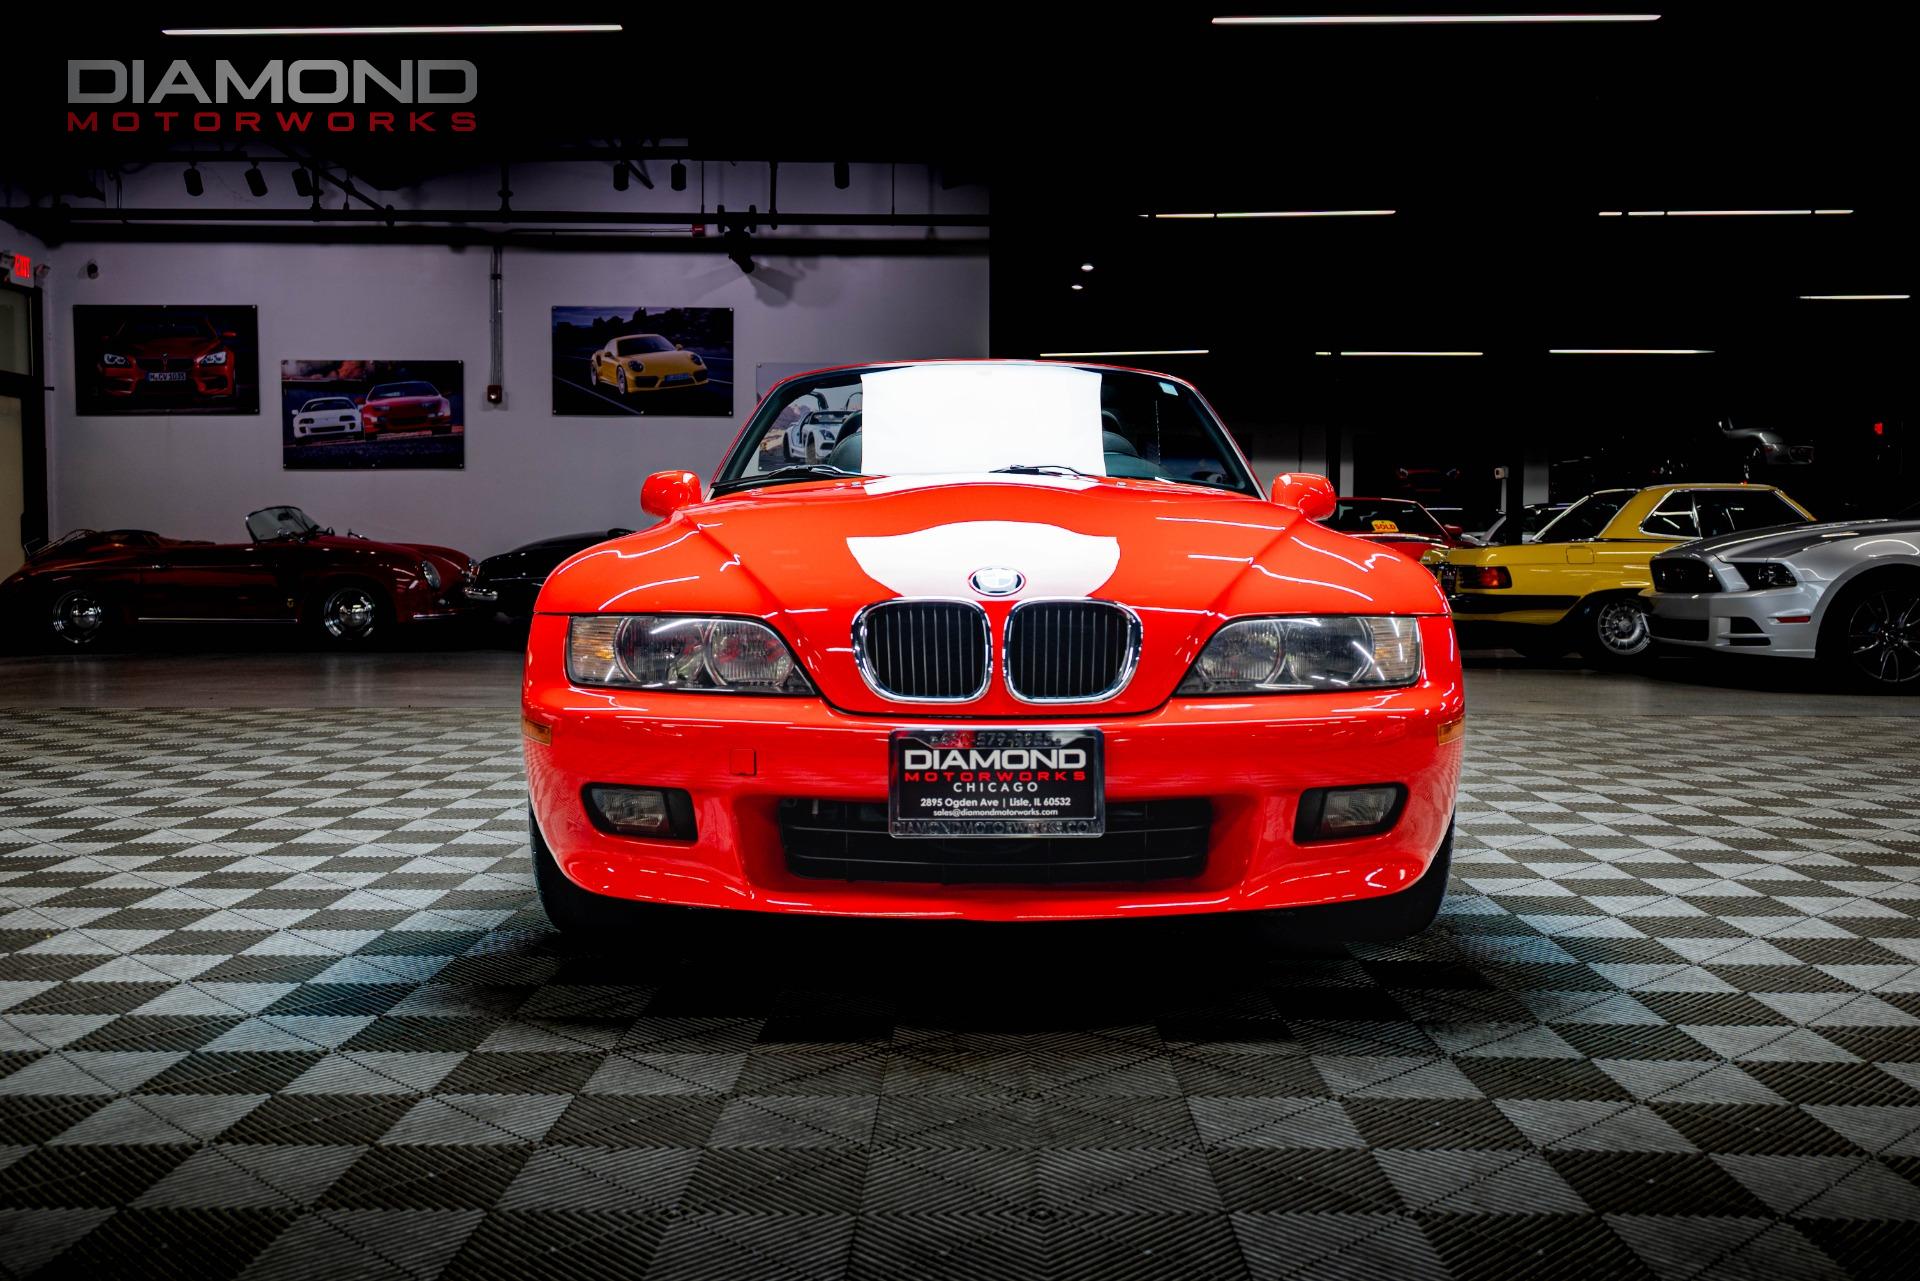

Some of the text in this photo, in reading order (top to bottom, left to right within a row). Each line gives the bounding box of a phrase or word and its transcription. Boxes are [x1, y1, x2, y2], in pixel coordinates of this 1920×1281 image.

[904, 749, 1086, 770] DIAMOND
[904, 771, 1086, 782] MOTORWORKS
[953, 782, 1038, 793] CHICAGO
[920, 798, 943, 807] 2895
[945, 798, 977, 808] Ogden
[980, 798, 999, 807] Ave
[1009, 797, 1032, 807] Lisle,
[1034, 797, 1041, 806] IL
[1043, 797, 1071, 806] 60532
[933, 808, 1058, 817] sales@diamondmotorworks.com
